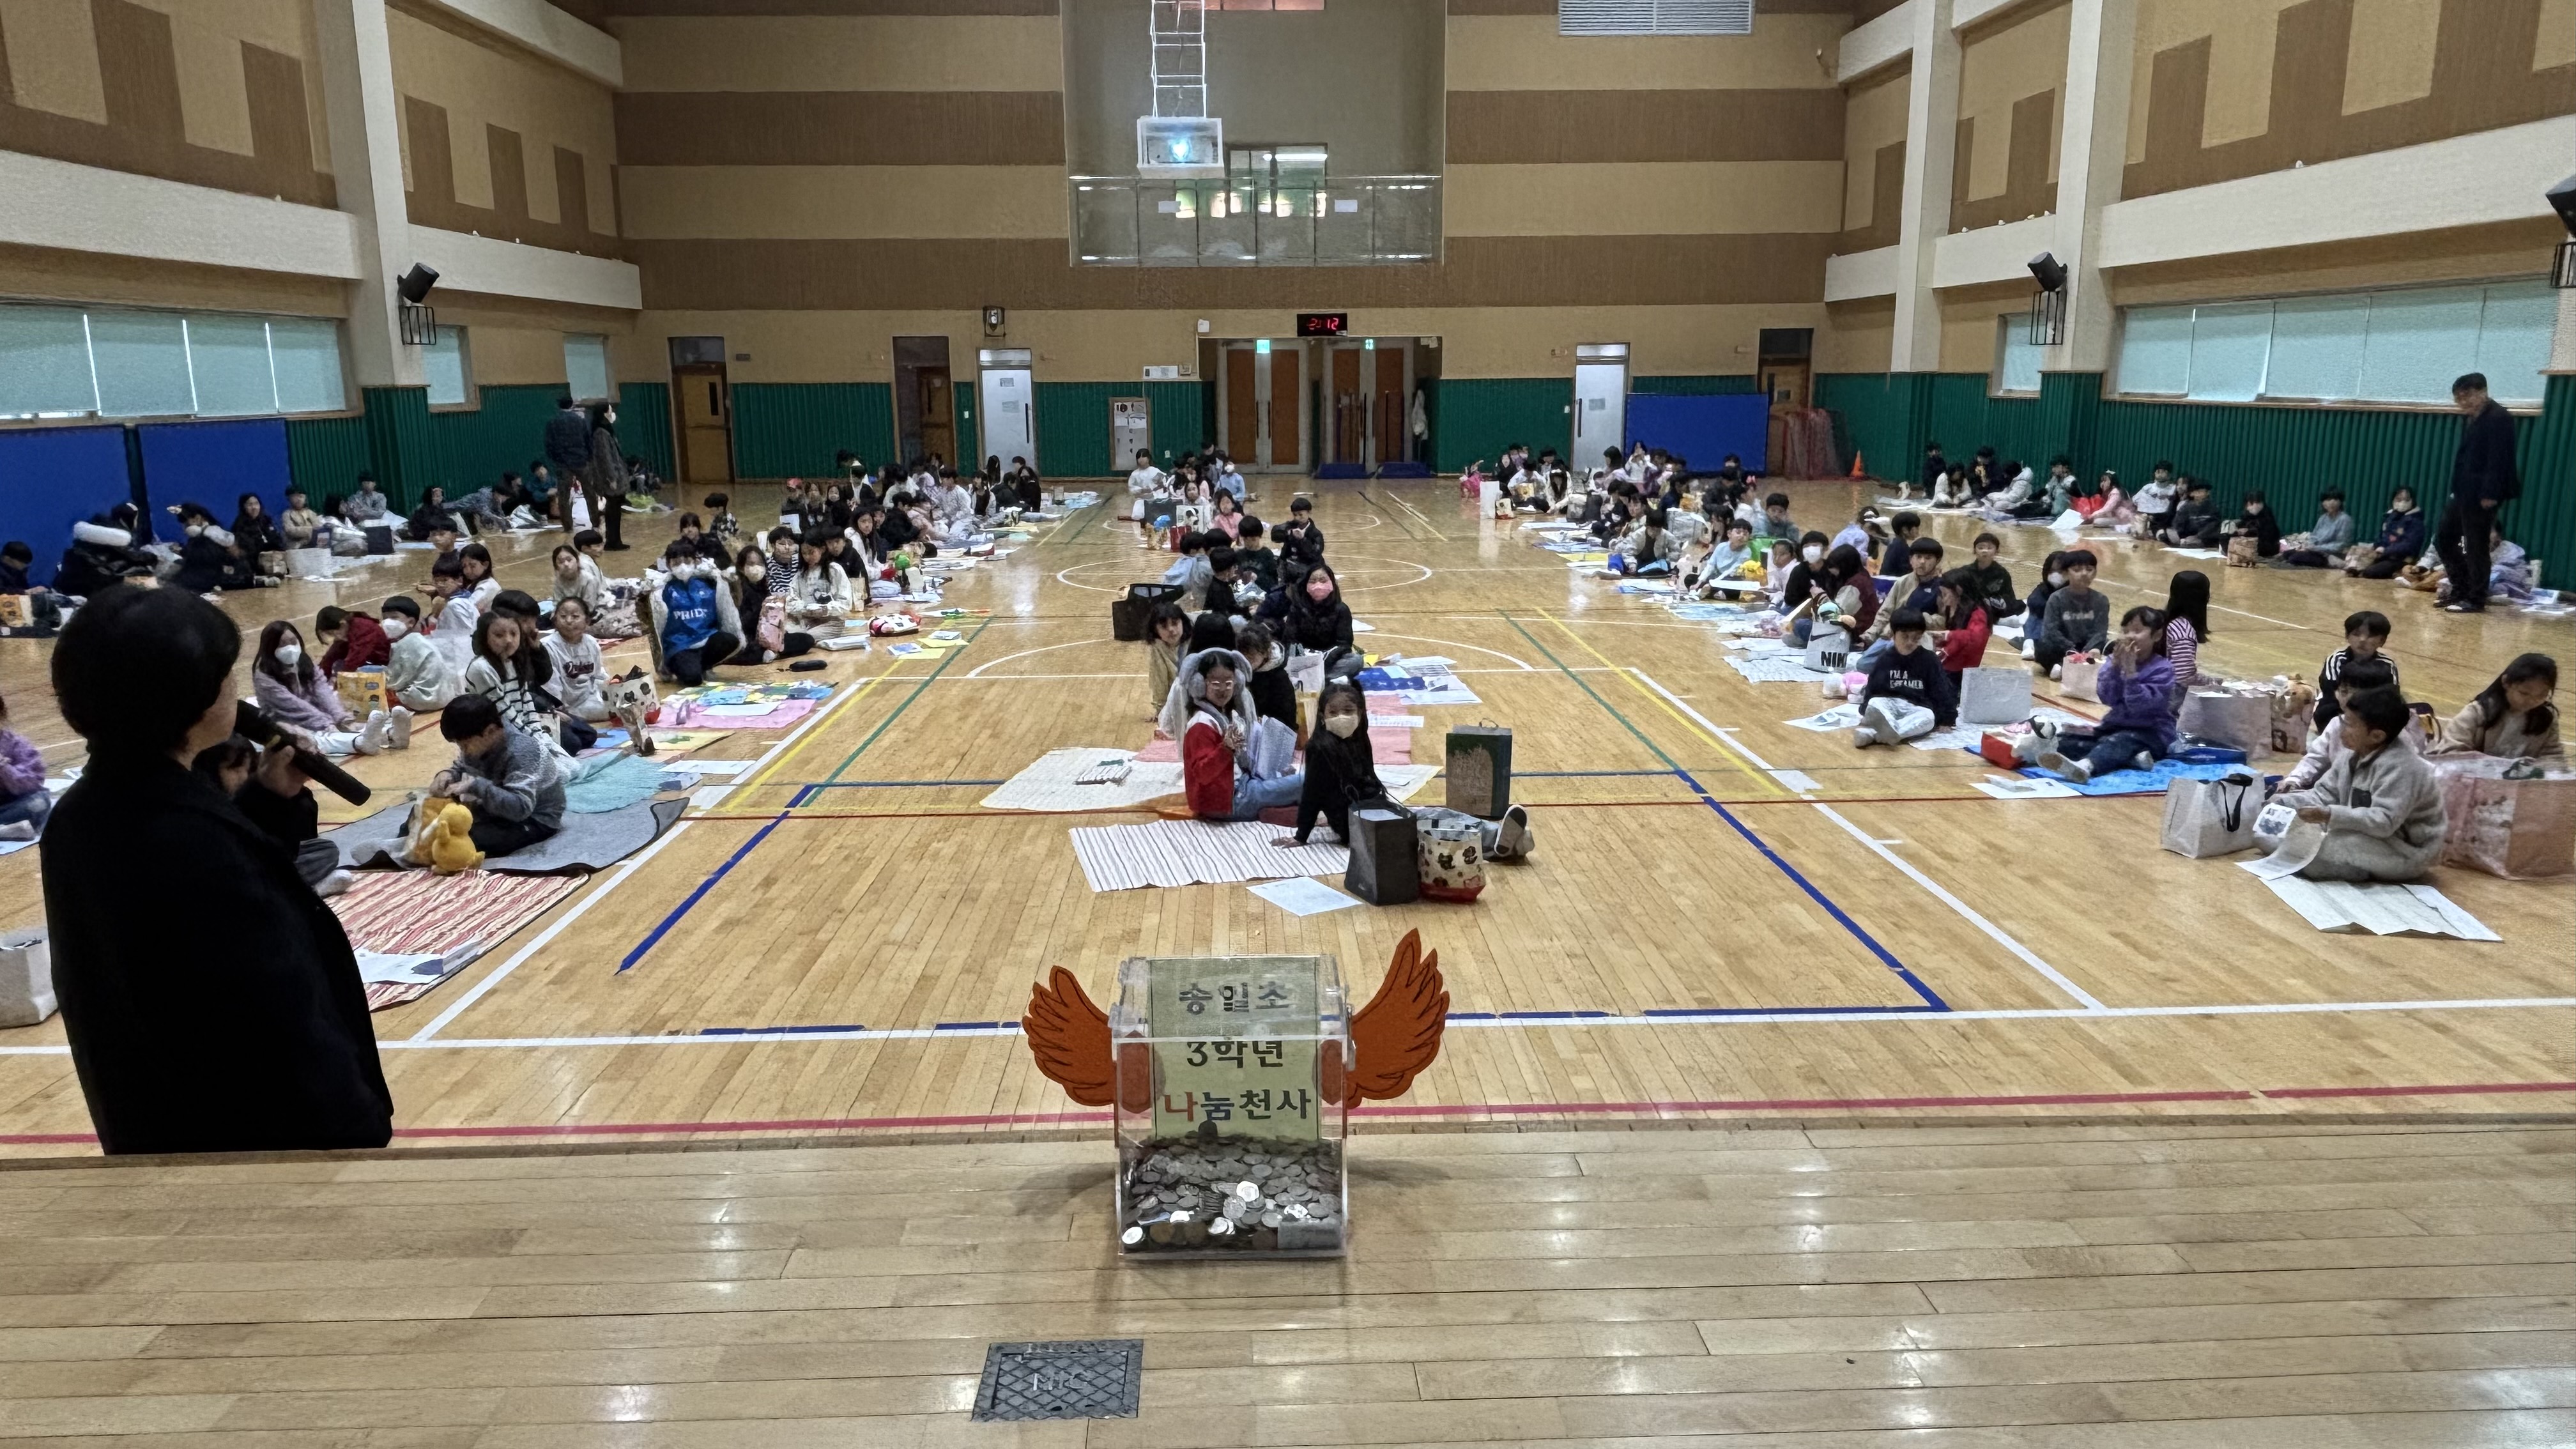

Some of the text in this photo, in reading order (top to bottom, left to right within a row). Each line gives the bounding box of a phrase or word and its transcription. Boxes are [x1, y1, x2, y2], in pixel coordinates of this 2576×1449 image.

[1179, 981, 1290, 1015] 송일초
[1186, 1040, 1284, 1069] 3학년
[1164, 1088, 1312, 1122] 나눔천사
